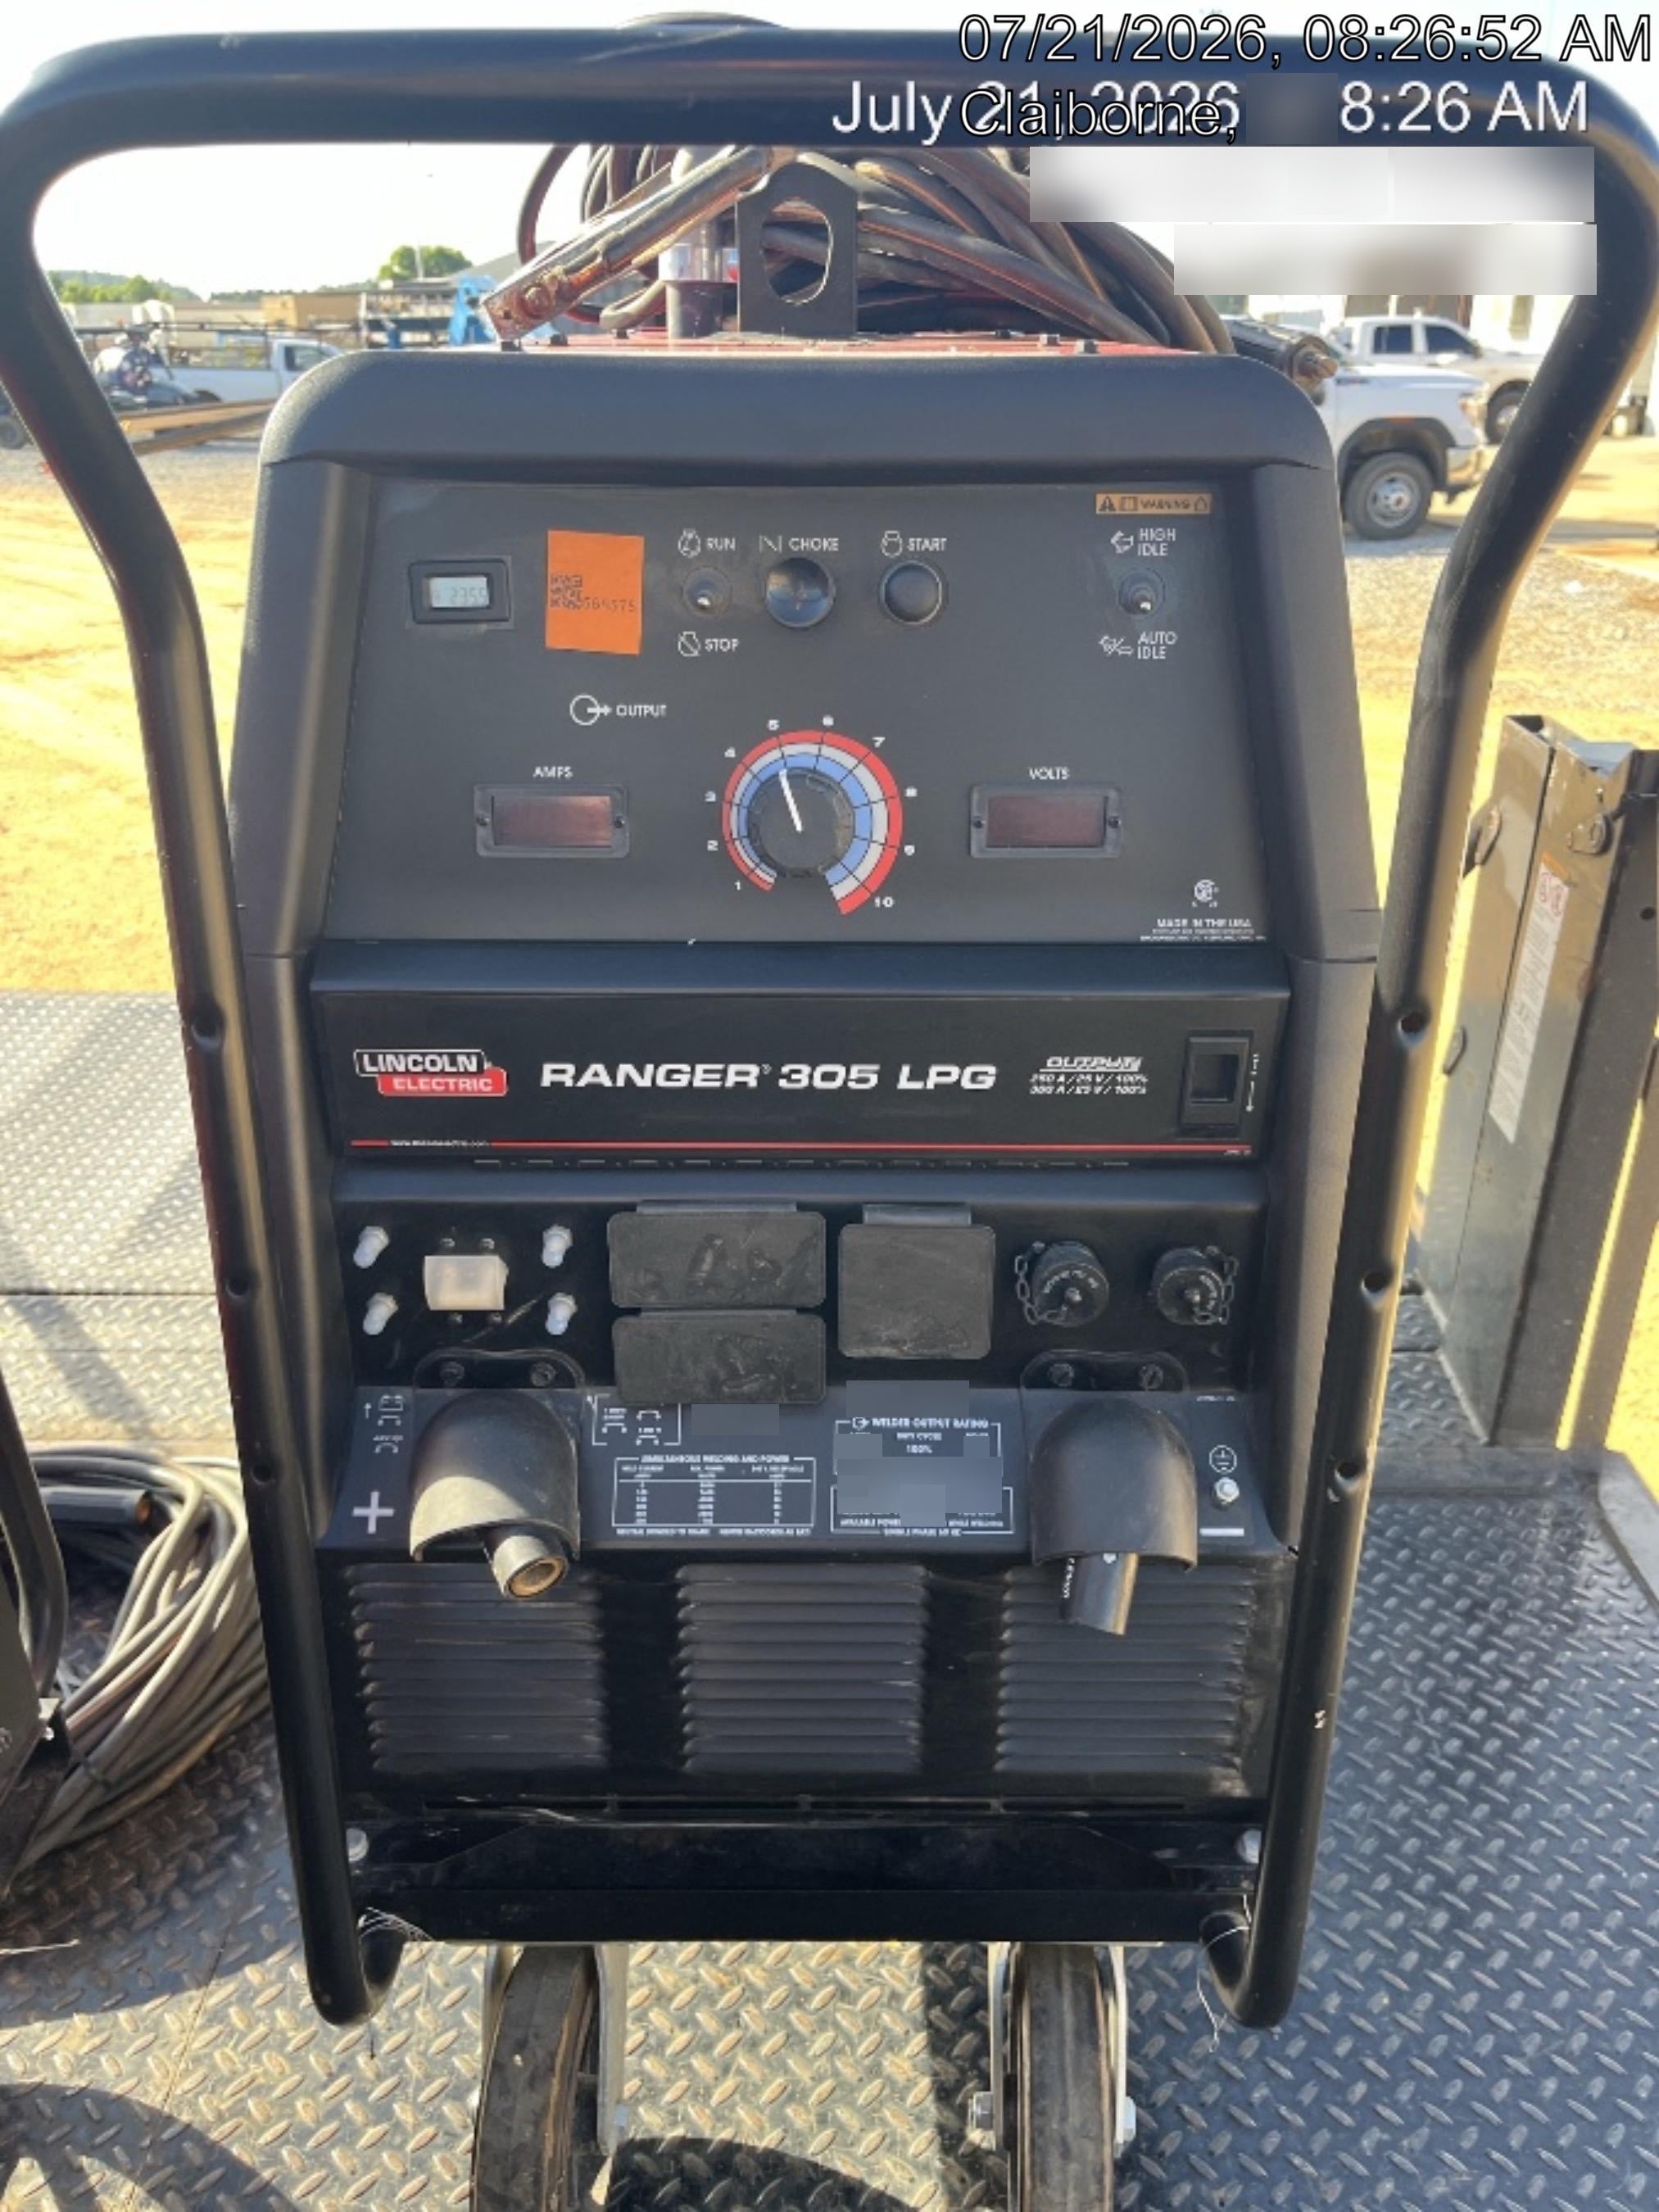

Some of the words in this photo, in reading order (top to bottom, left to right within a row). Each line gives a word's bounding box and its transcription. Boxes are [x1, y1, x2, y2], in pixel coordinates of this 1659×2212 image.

[1138, 528, 1176, 542] HIGH
[706, 537, 736, 551] RUN
[788, 537, 839, 552] CHOKE
[907, 537, 947, 552] START
[1137, 543, 1168, 557] IDLE
[705, 638, 739, 653] STOP
[1137, 632, 1176, 646] AUTO
[1137, 646, 1167, 660] IDLE
[616, 705, 668, 718] OUTPUT
[767, 718, 779, 731] 5
[873, 737, 886, 748] 7
[533, 766, 573, 779] AMPS
[1028, 767, 1069, 781] VOLTS
[873, 896, 895, 909] 10
[362, 1054, 478, 1073] LINCOLN
[777, 1064, 881, 1090] 305
[896, 1064, 998, 1090] LPG
[392, 1078, 493, 1092] ELECTRIC
